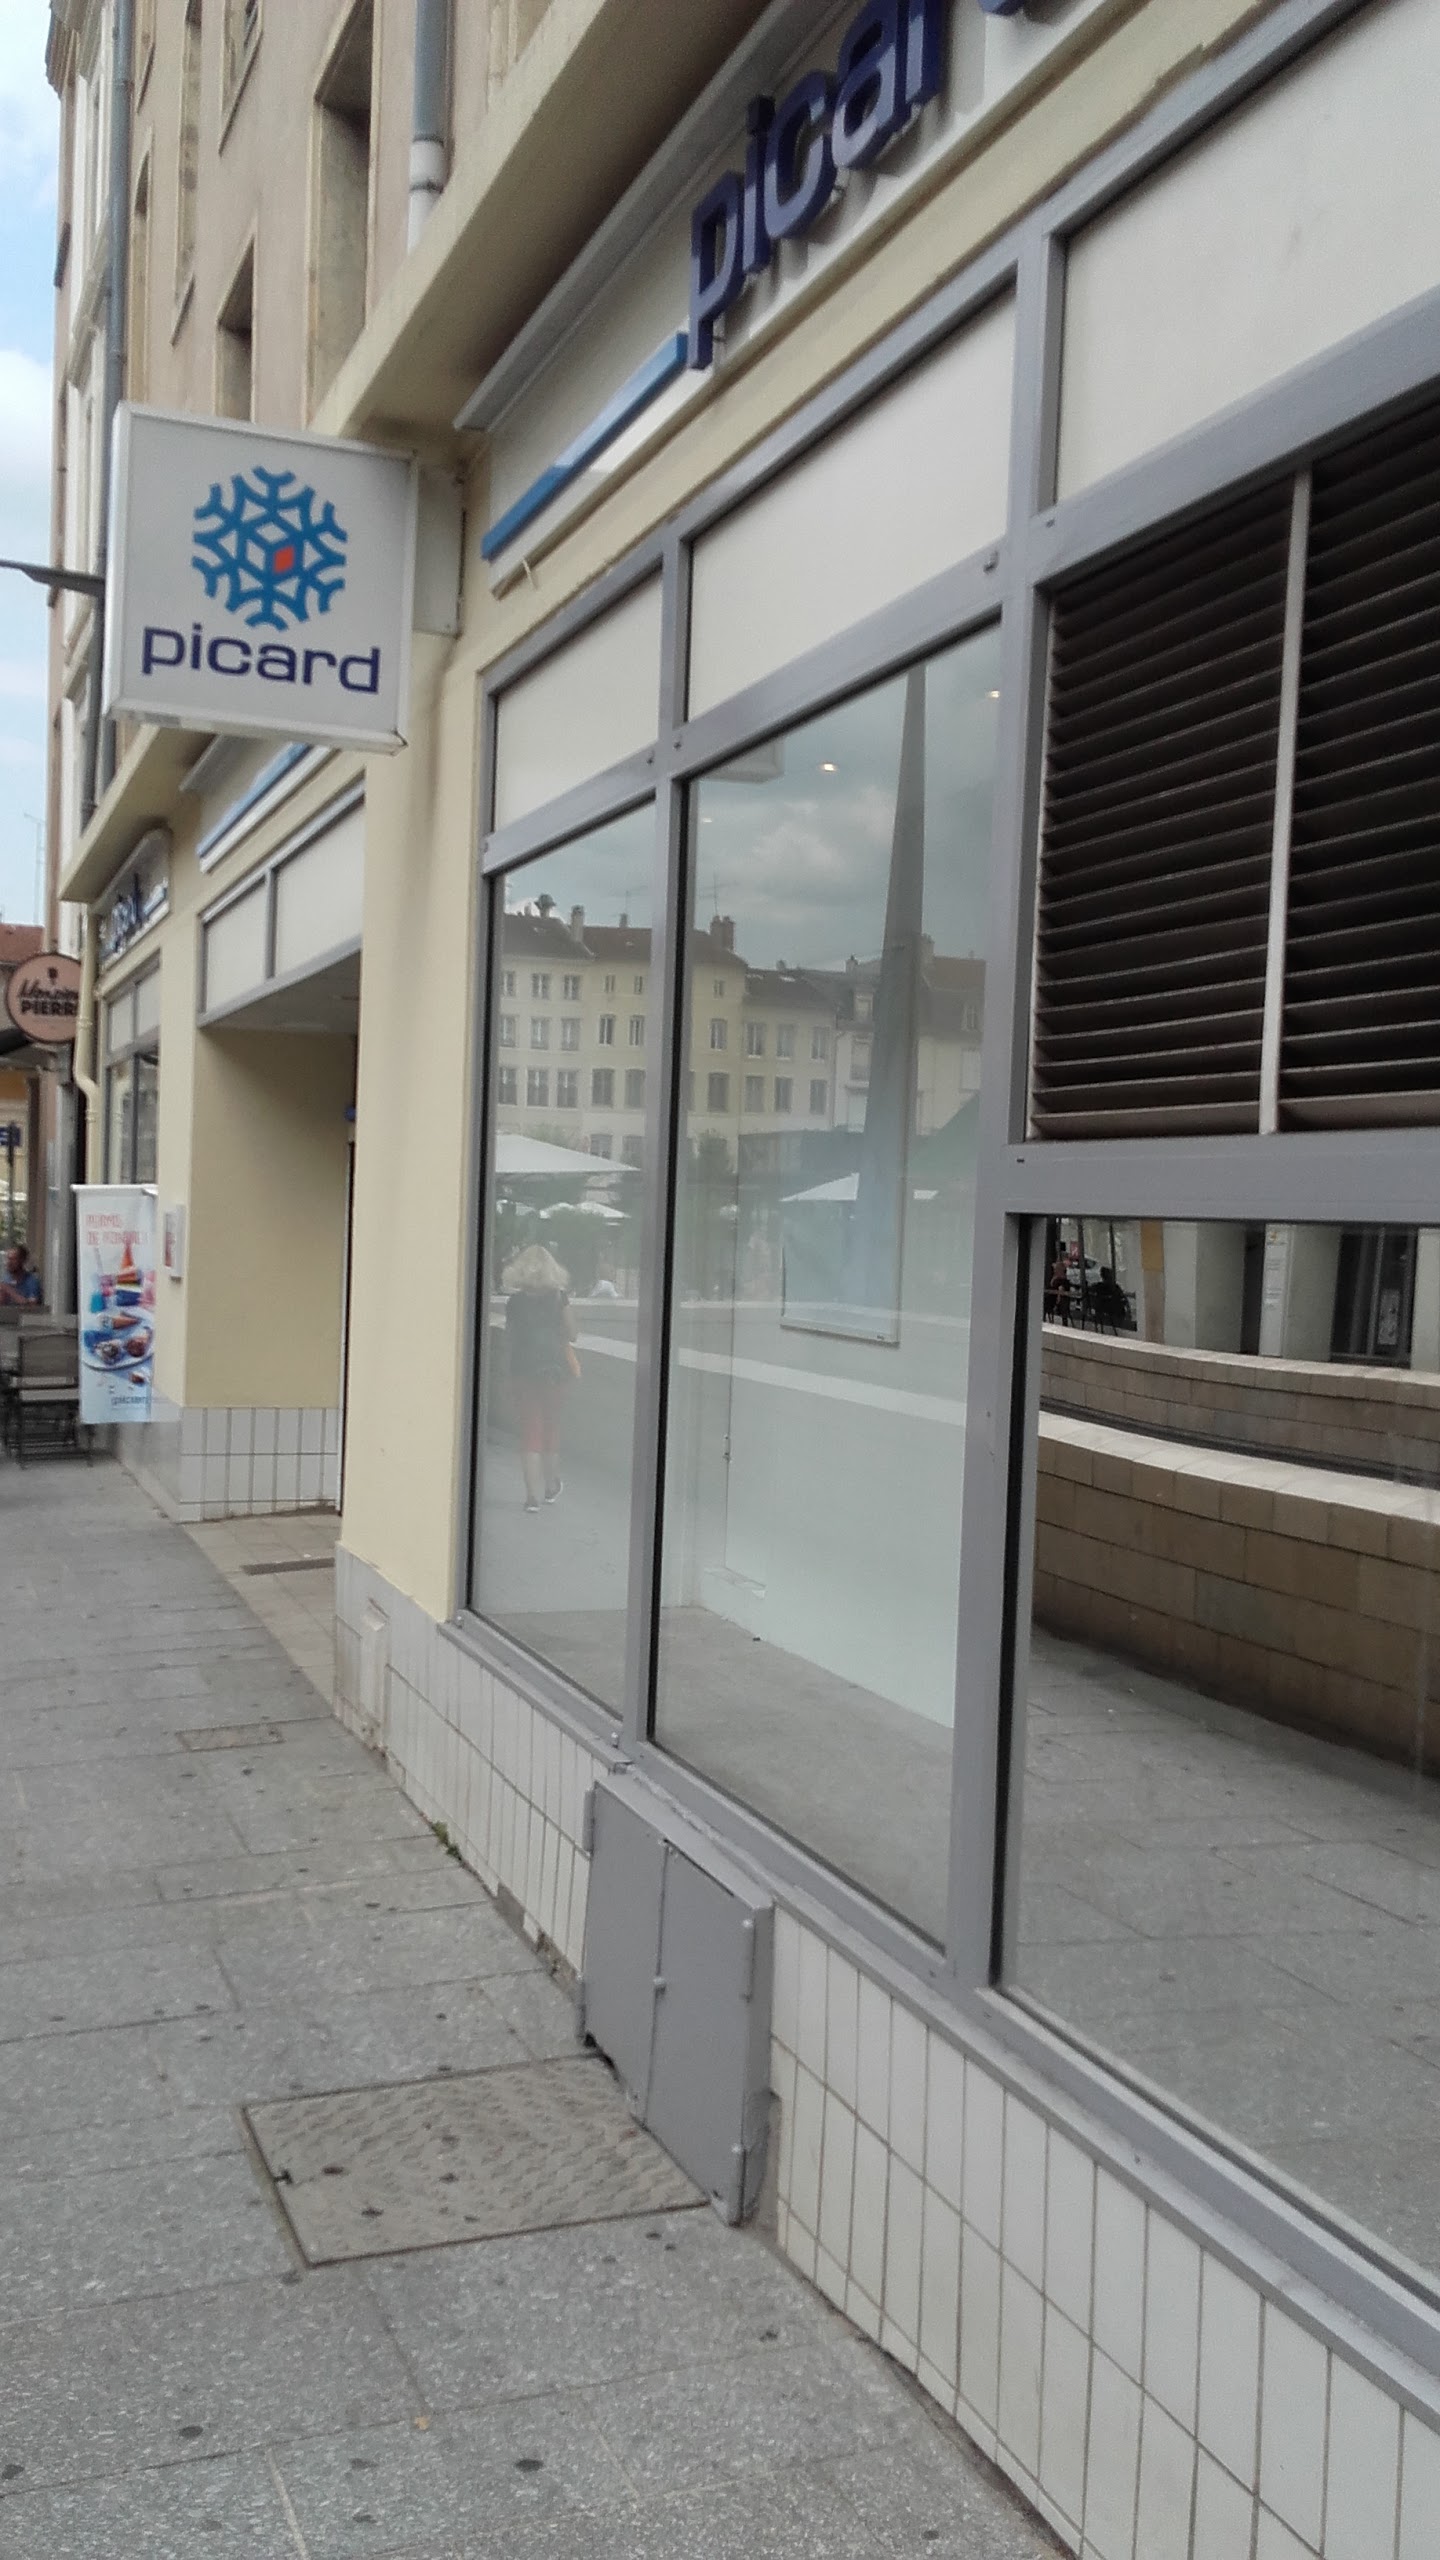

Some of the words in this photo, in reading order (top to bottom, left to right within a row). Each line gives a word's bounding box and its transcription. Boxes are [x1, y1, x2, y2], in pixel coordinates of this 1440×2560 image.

[687, 0, 1022, 369] pica
[141, 622, 381, 694] picard
[21, 1000, 78, 1016] PIERR
